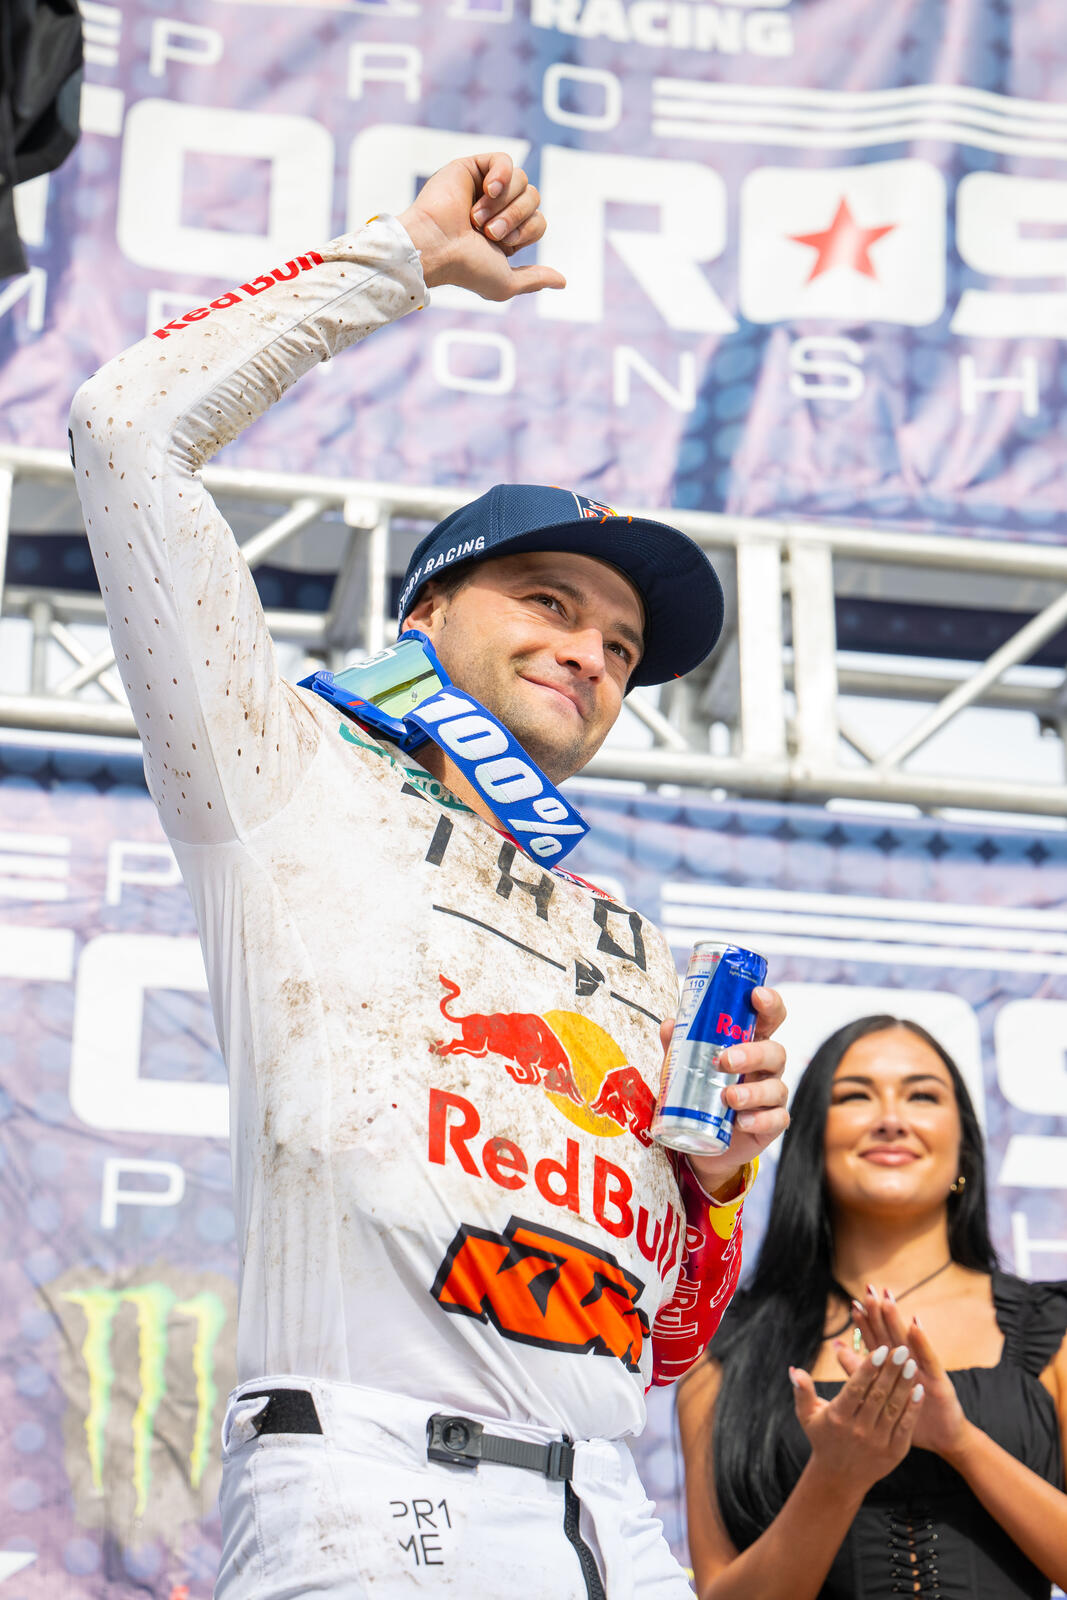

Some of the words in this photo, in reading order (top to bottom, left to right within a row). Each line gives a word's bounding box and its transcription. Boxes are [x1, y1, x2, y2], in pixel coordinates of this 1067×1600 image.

[531, 0, 795, 56] RACING
[423, 536, 485, 574] RACING
[413, 692, 586, 859] 100%
[716, 1012, 753, 1044] Red
[427, 1088, 580, 1215] Red
[593, 1155, 682, 1283] Bull
